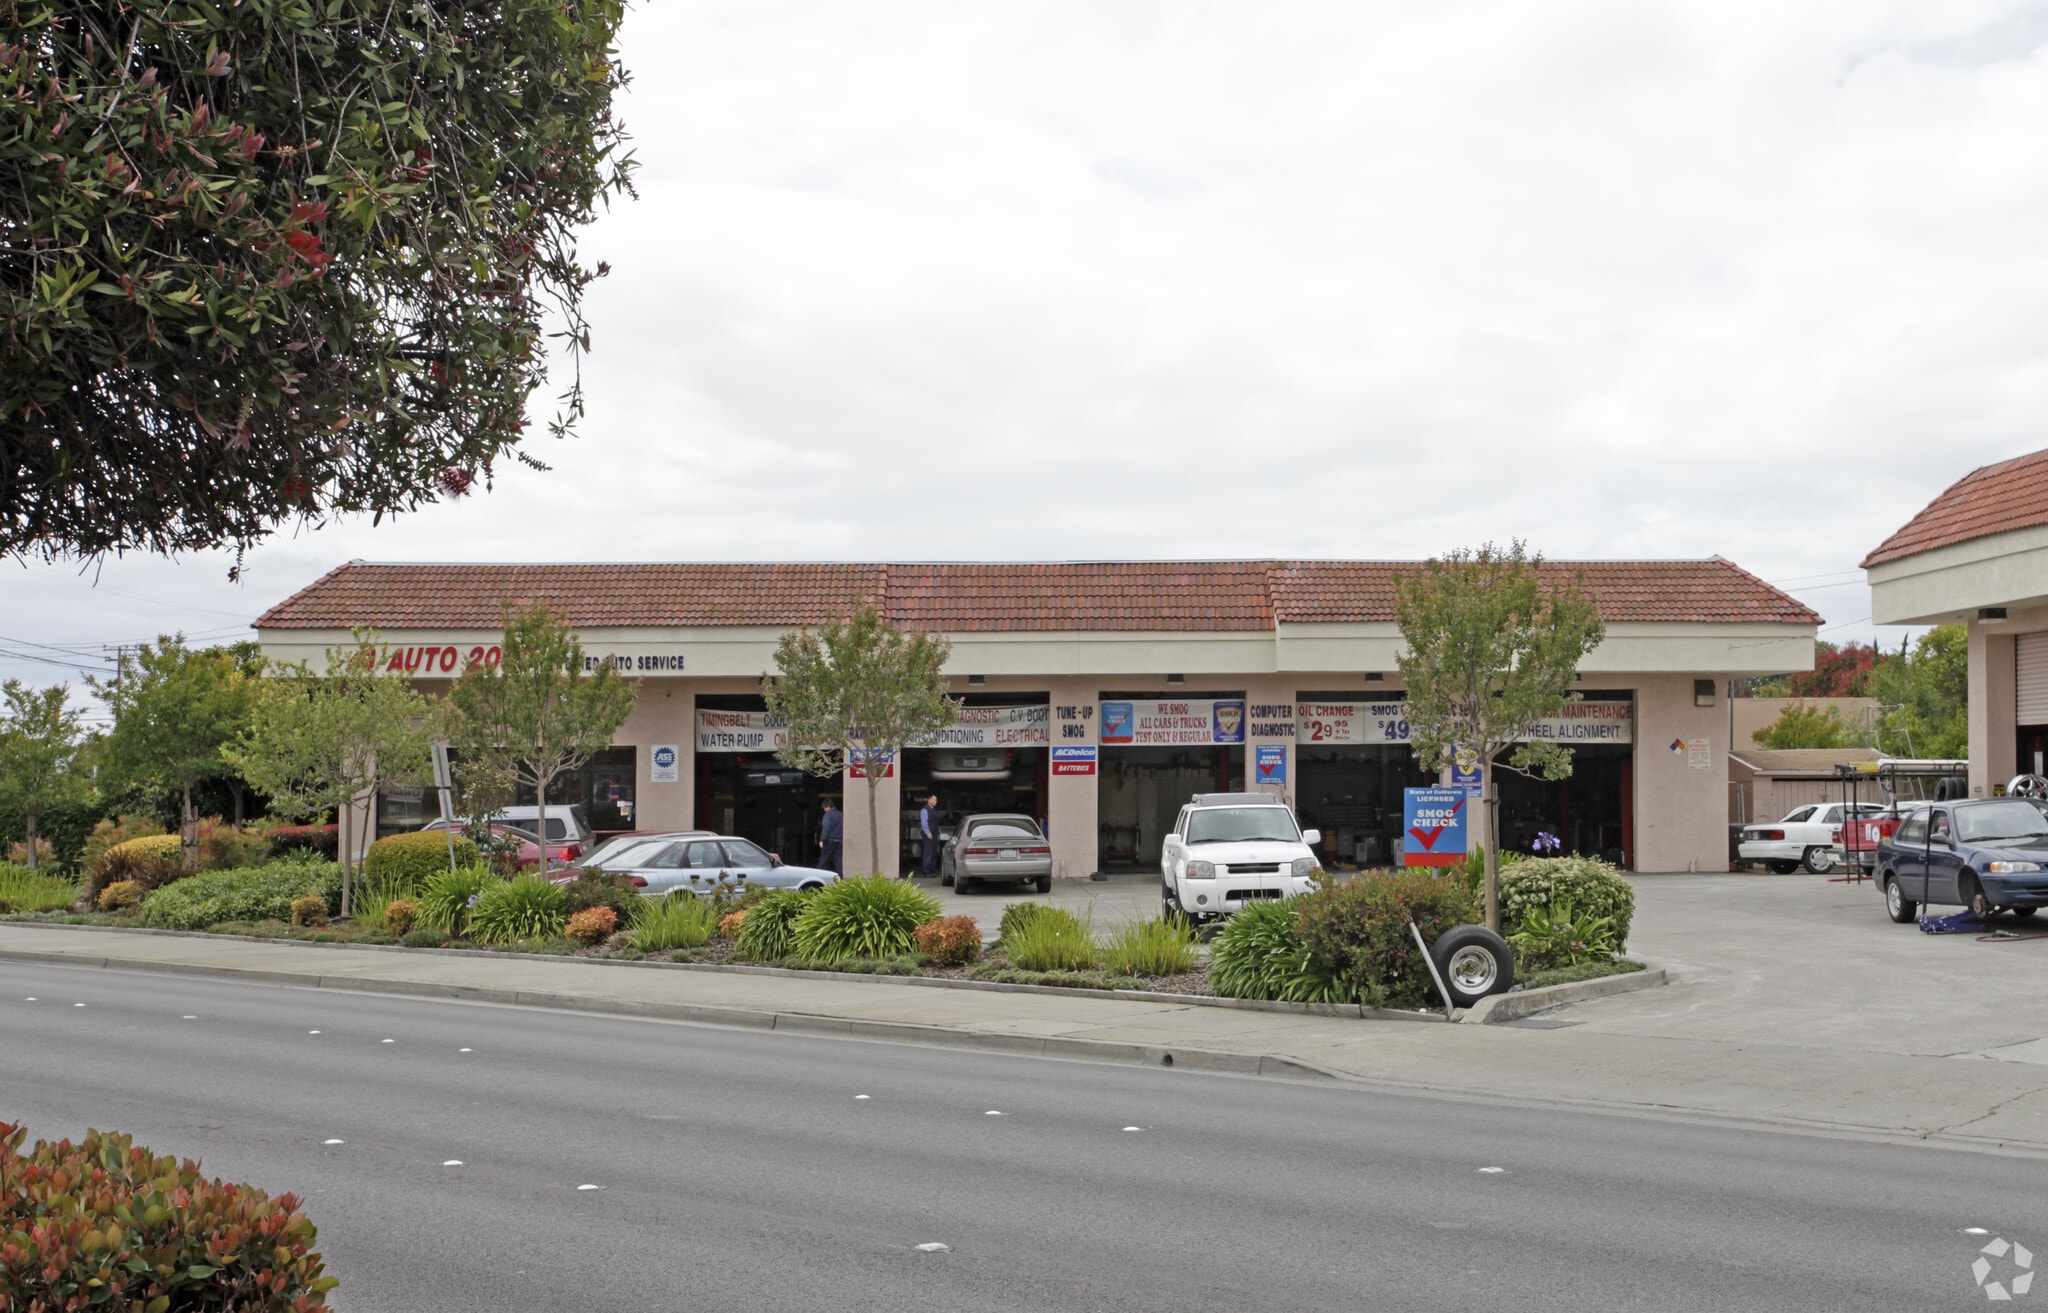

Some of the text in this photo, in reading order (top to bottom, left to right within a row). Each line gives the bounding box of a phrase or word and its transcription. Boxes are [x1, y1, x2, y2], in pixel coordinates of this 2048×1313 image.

[386, 646, 458, 672] AUTO
[637, 655, 684, 670] SERVICE
[1056, 706, 1093, 720] TUNE-UP
[1158, 703, 1189, 715] WE SMOG
[1250, 705, 1293, 719] COMPUTER
[1298, 705, 1354, 717] OIL CHANGE
[1371, 704, 1398, 716] SMOG
[1562, 705, 1632, 719] MAINTENANCE
[763, 713, 789, 727] COOL
[956, 710, 1000, 725] IAGNOSTIC
[1139, 718, 1153, 729] ALL
[1154, 717, 1172, 729] CARS
[1180, 717, 1207, 729] TRUCKS
[995, 728, 1049, 744] ELECTRICAL
[1062, 724, 1085, 738] SMOG
[1135, 731, 1152, 743] TEST
[1153, 731, 1171, 743] ONLY
[1179, 731, 1211, 743] REGULAR
[1251, 723, 1295, 738] DIAGNOSTIC
[1559, 724, 1620, 739] ALIGNMENT
[701, 733, 735, 748] WATER
[737, 733, 763, 747] PUMP
[1054, 748, 1095, 757] ACDelco
[1057, 764, 1090, 773] BATTERIES
[1416, 809, 1455, 818] SMOG
[1412, 818, 1459, 827] CHECK
